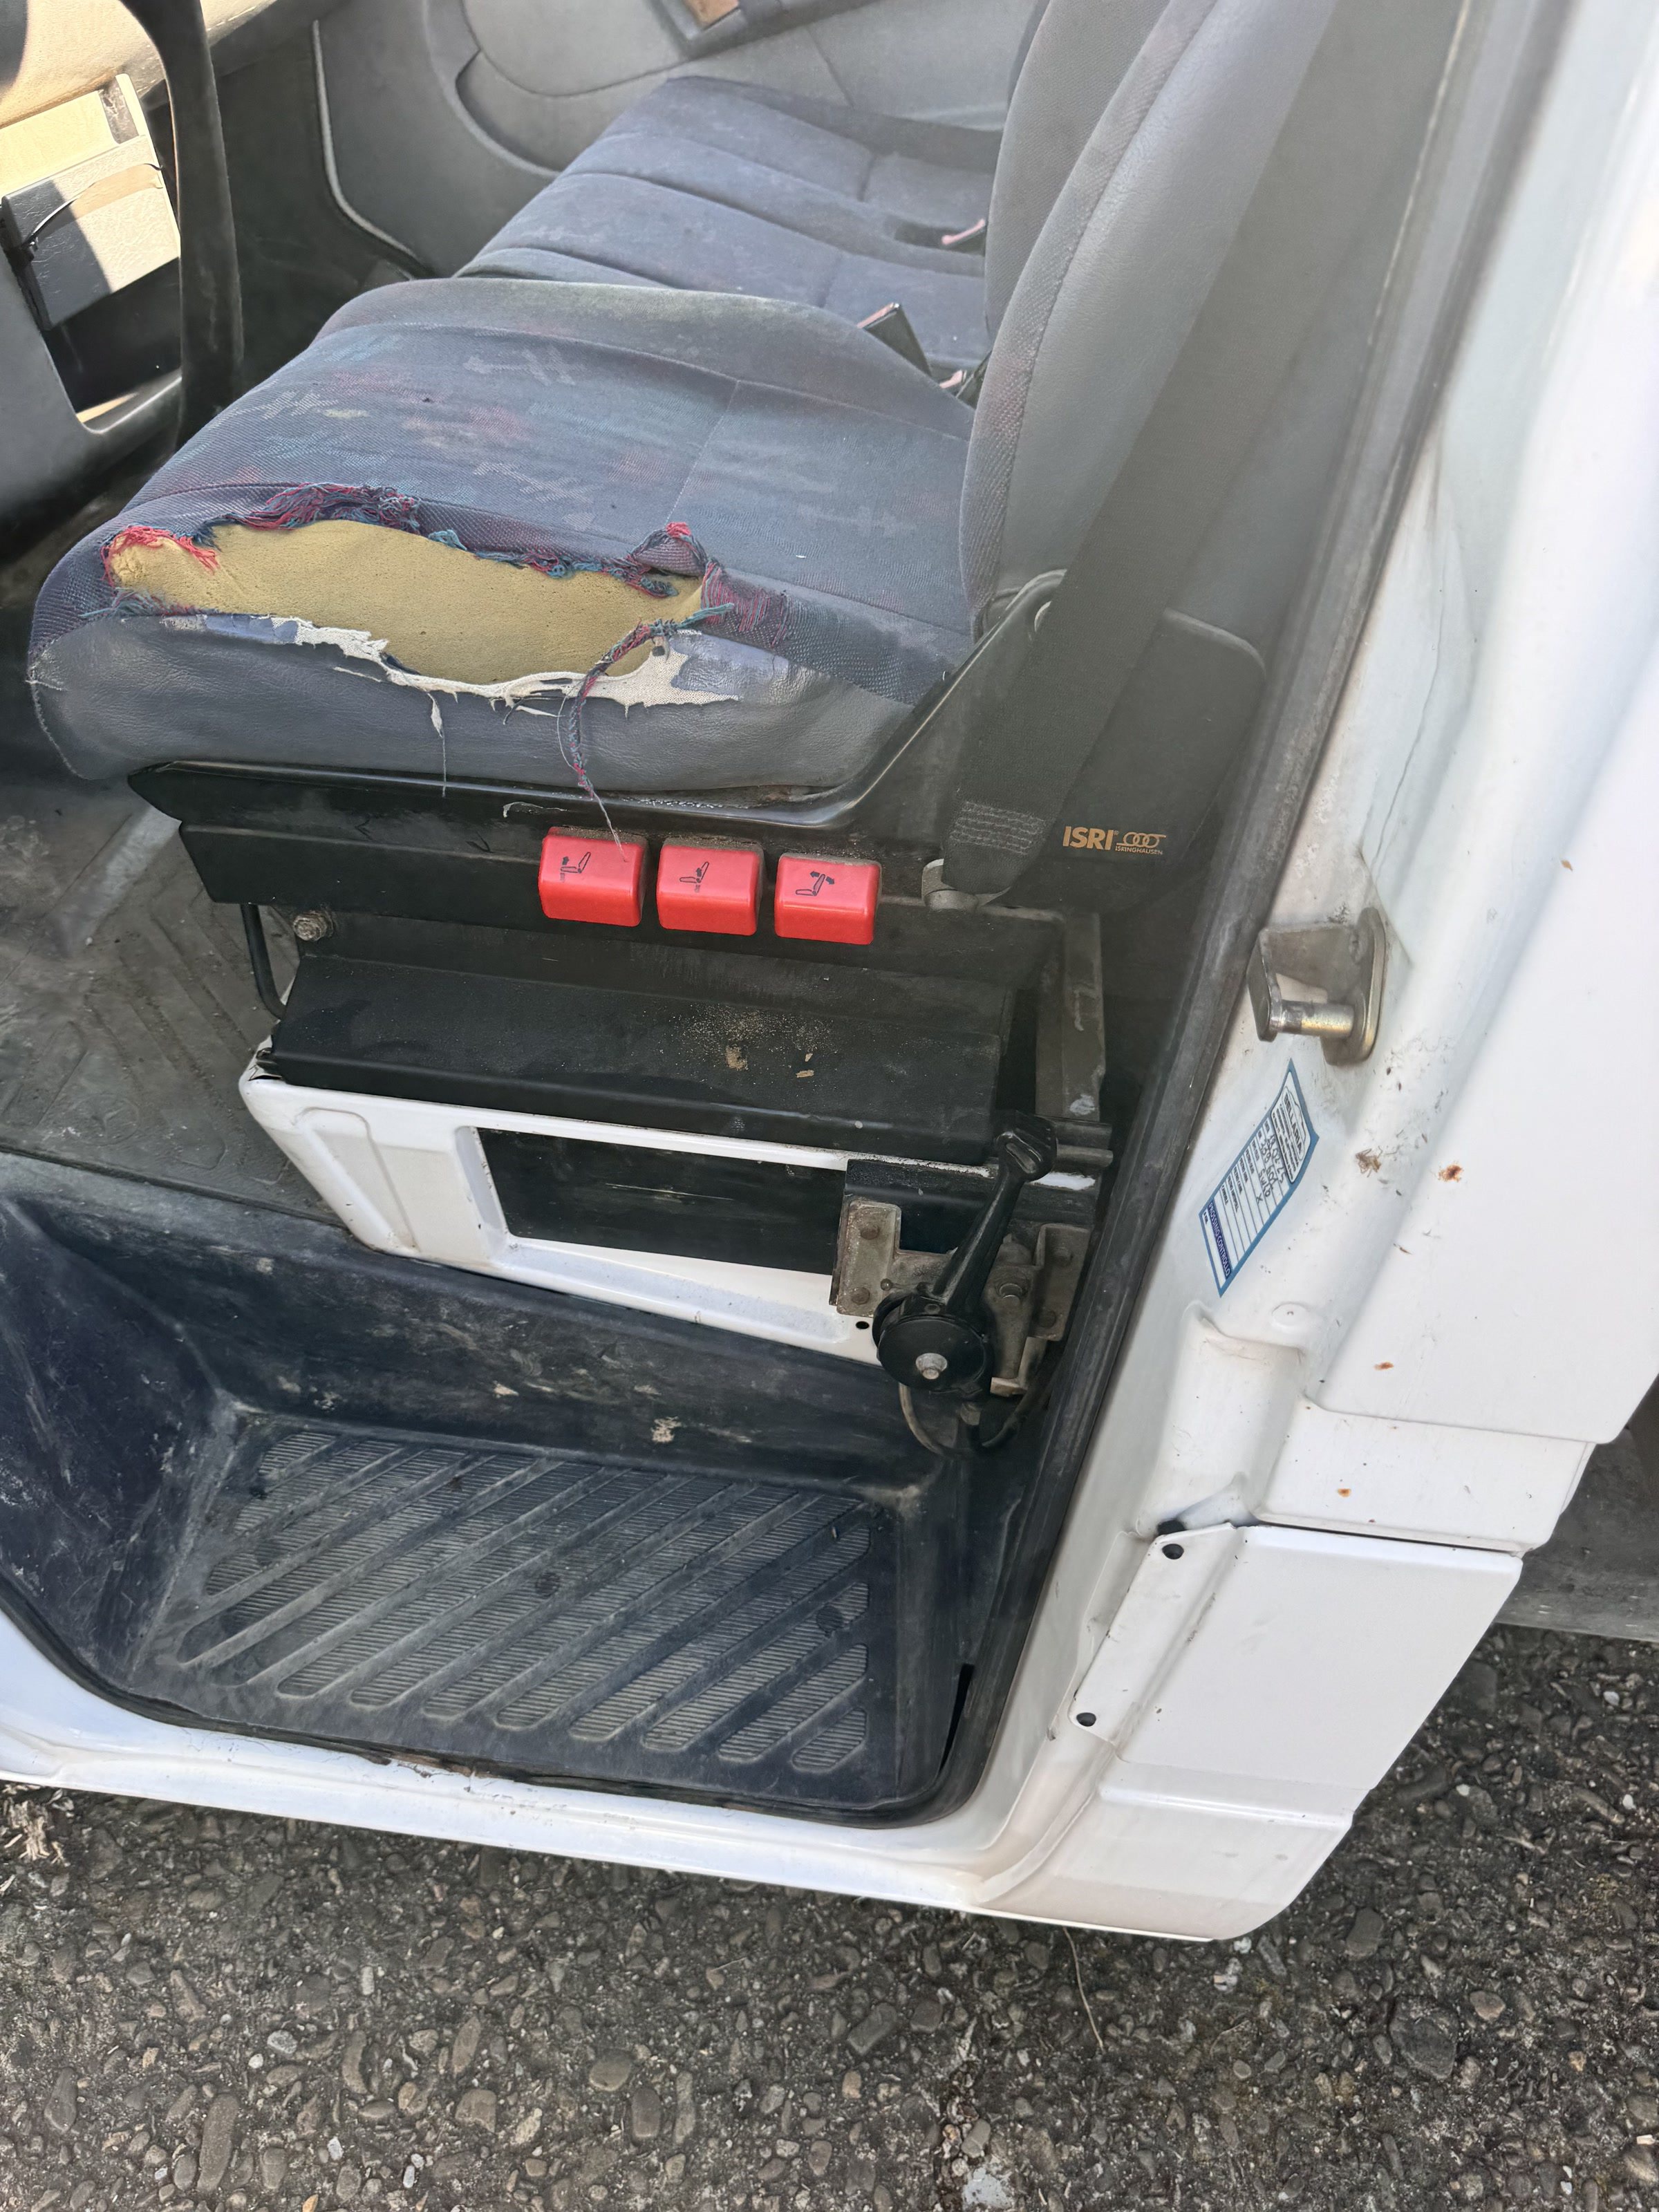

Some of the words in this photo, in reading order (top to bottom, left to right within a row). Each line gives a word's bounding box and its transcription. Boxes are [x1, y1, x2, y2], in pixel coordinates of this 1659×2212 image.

[1115, 845, 1163, 855] ISRINGHAUSEN
[1284, 1093, 1302, 1154] BELLARIA
[1209, 1201, 1219, 1237] PROSSIMO
[1217, 1233, 1230, 1277] CONTROLLO
